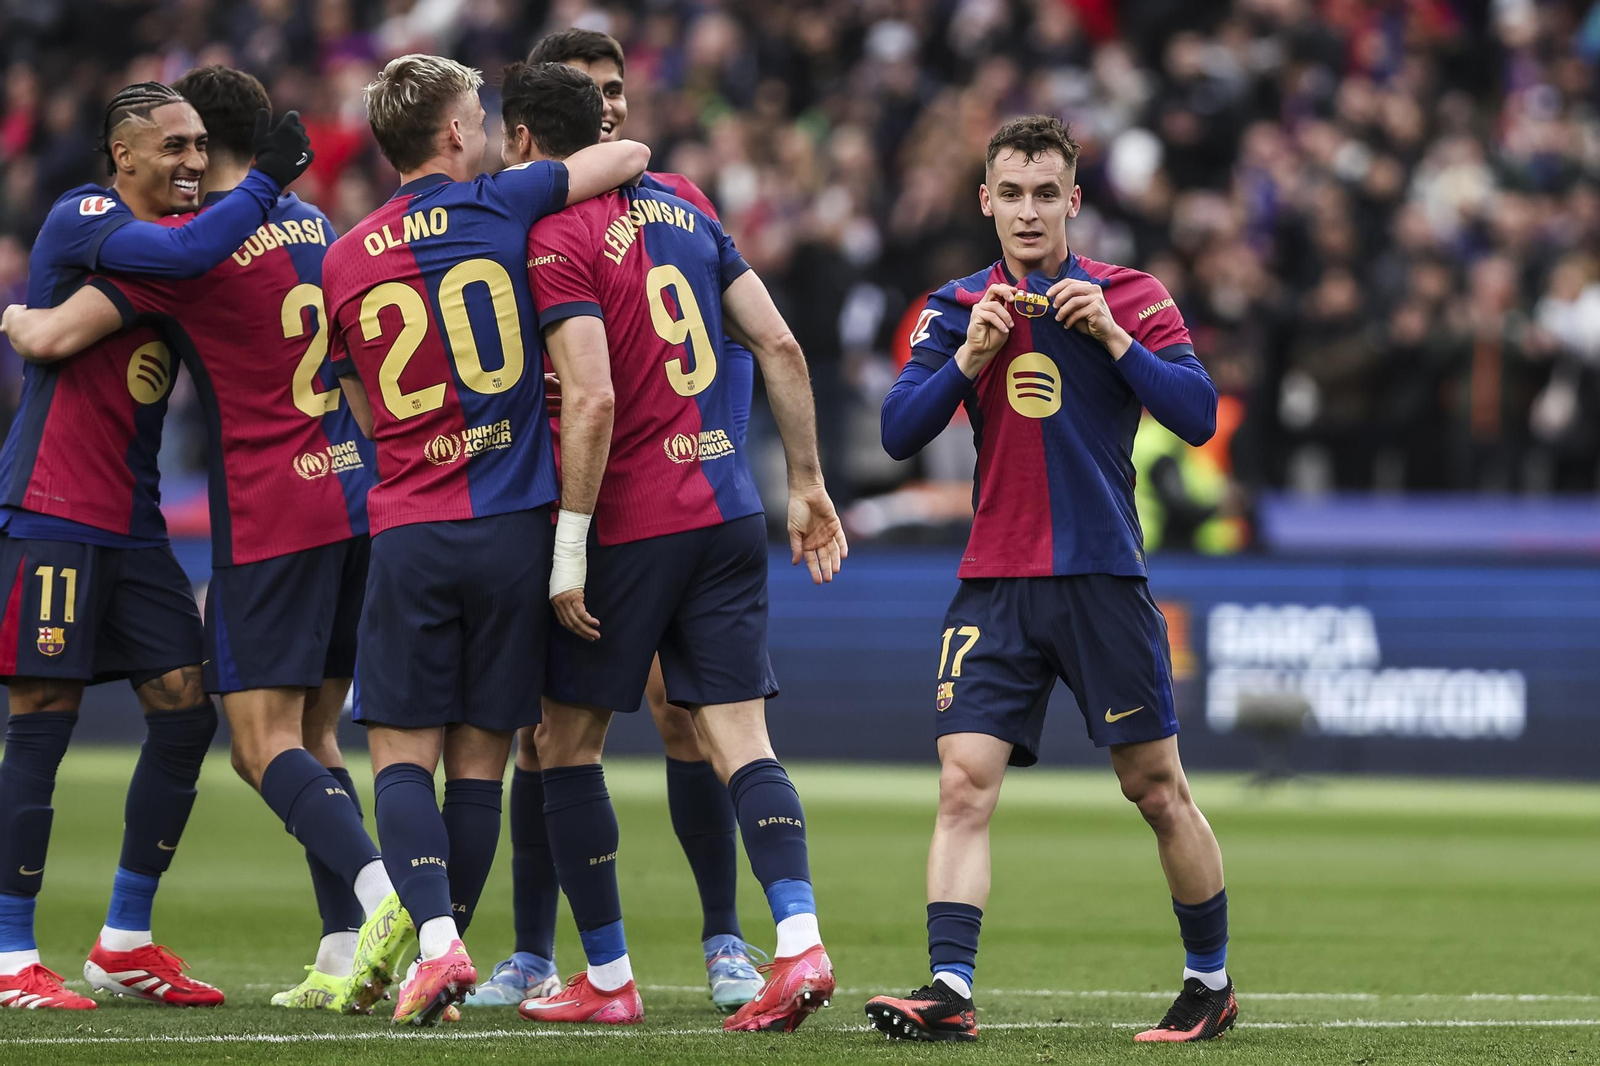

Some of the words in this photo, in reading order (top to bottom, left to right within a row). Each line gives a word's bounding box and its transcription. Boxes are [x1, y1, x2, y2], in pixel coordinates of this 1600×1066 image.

[364, 207, 448, 256] OLMO
[281, 283, 341, 417] 2
[359, 258, 524, 420] 20
[646, 264, 717, 397] 9
[461, 419, 510, 441] UNHCR
[463, 431, 511, 453] ACNUR
[35, 566, 76, 622] 11
[938, 626, 980, 679] 17
